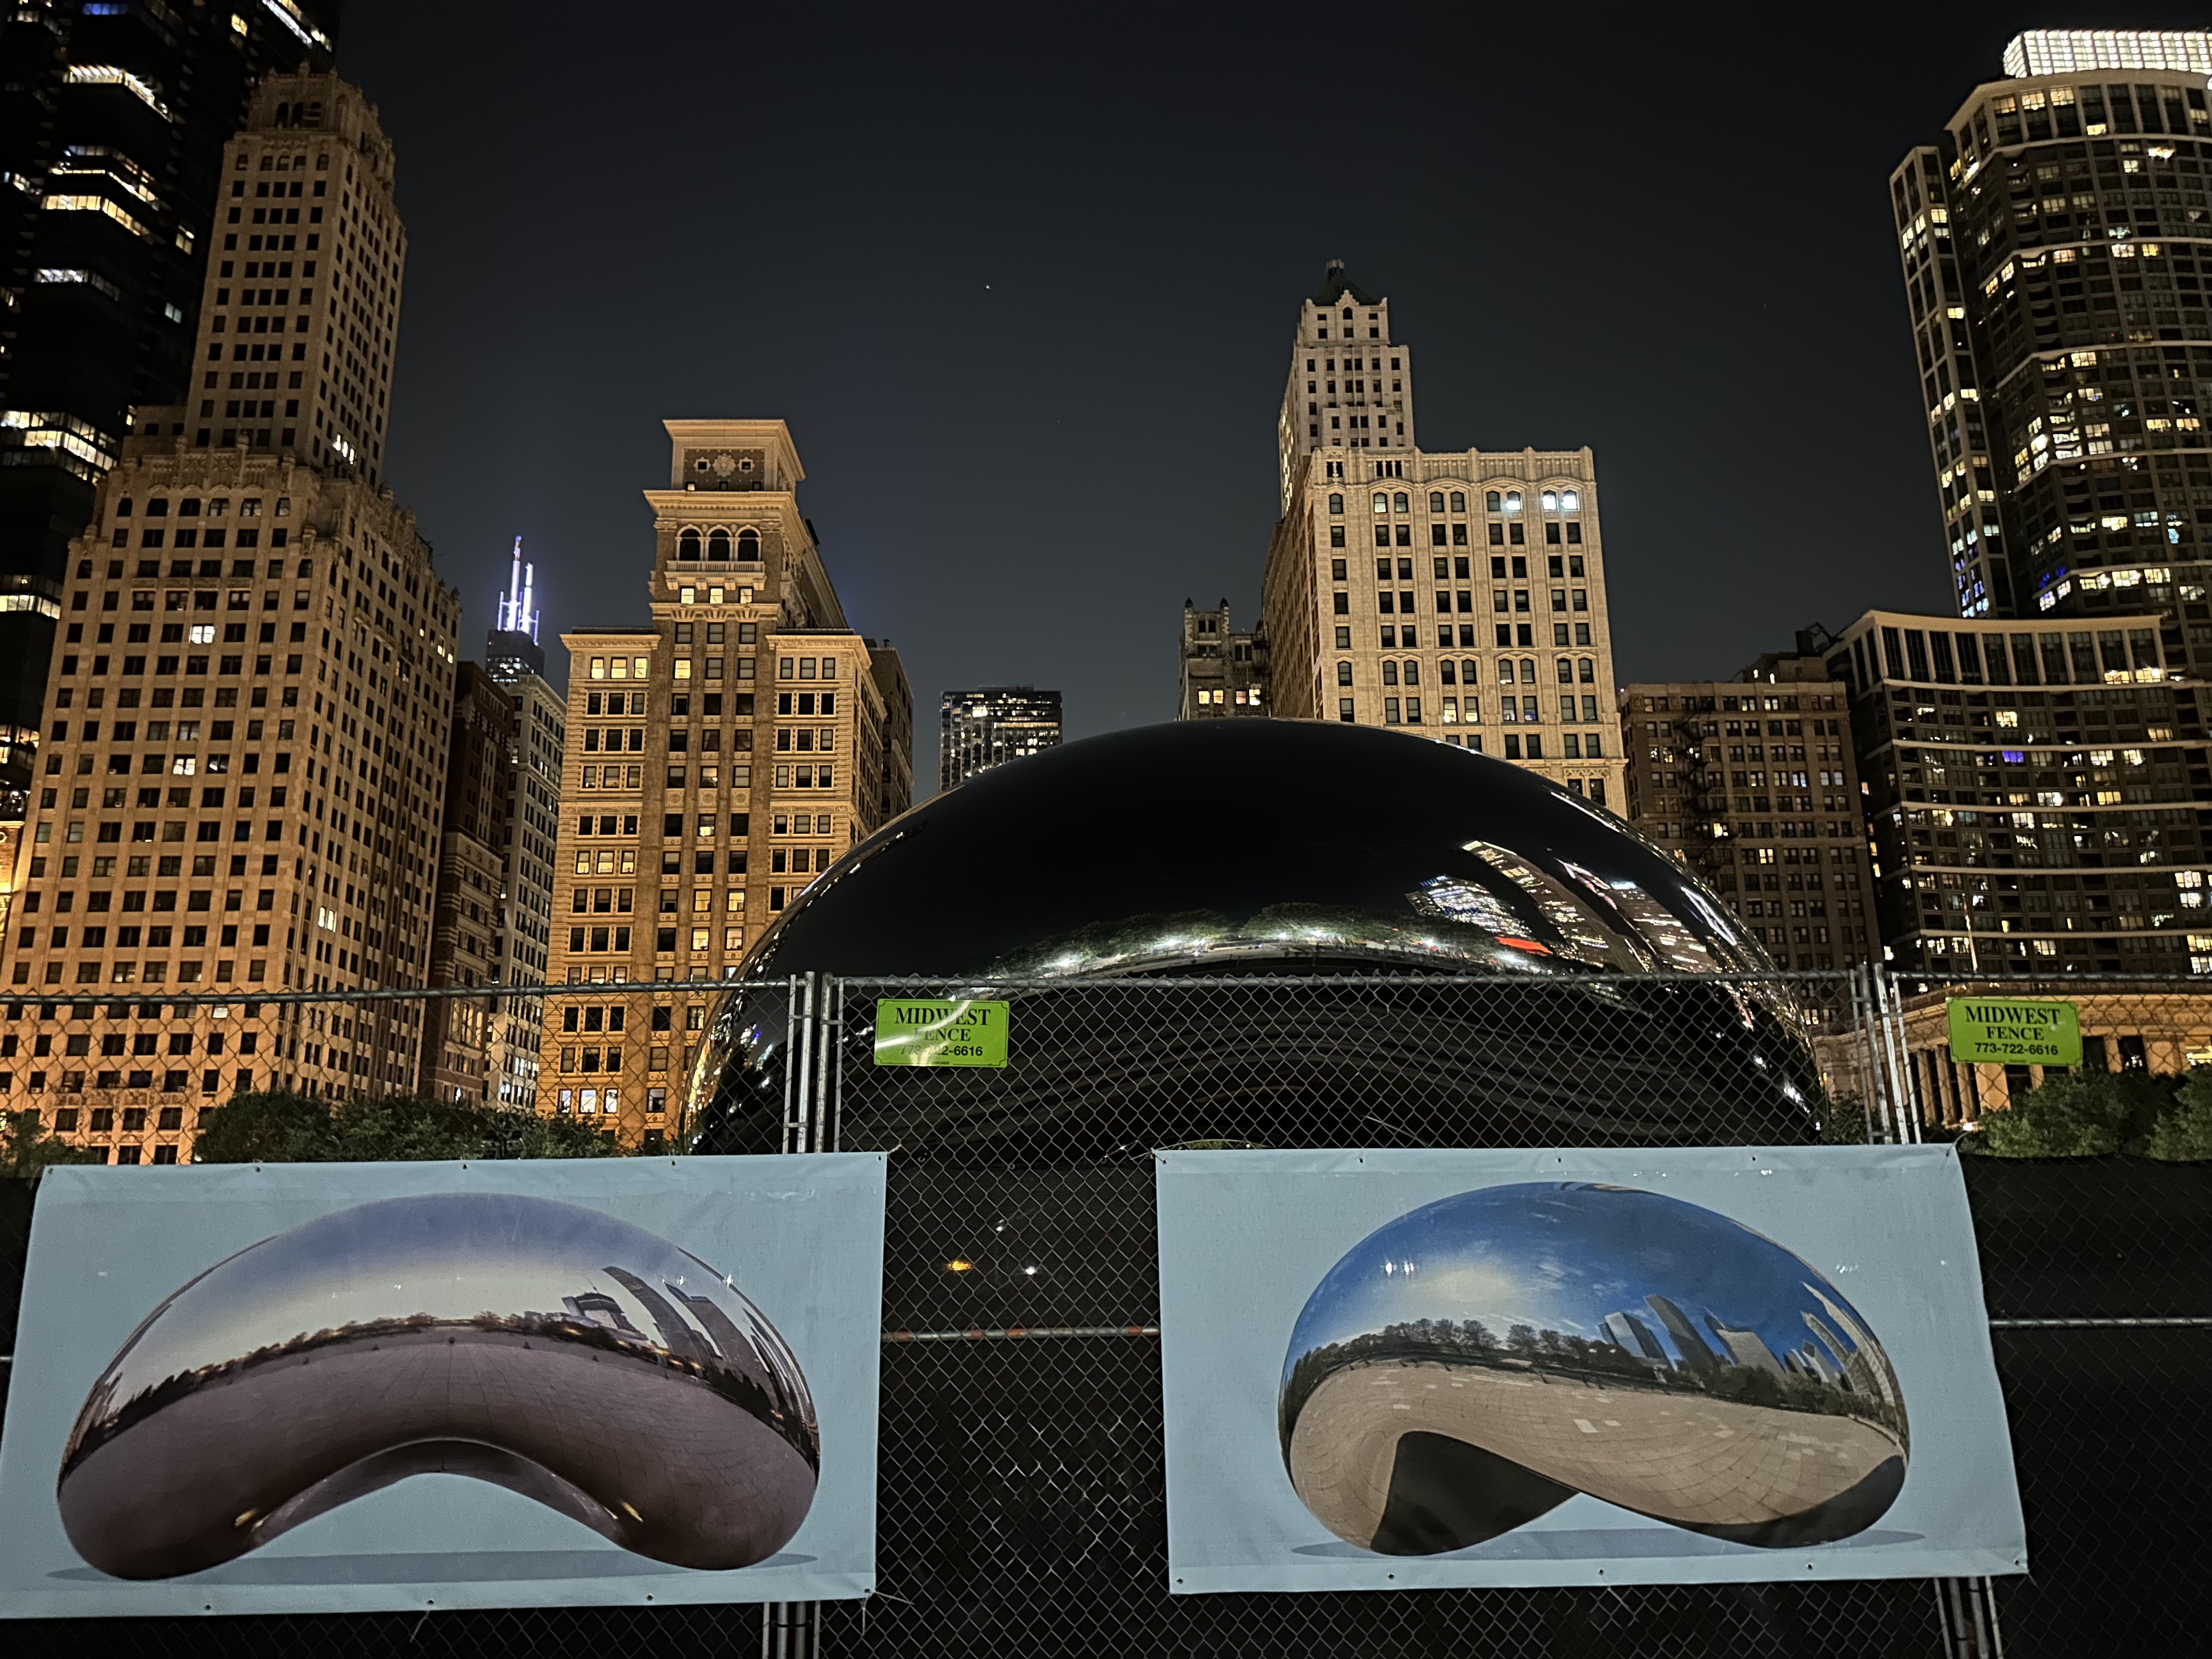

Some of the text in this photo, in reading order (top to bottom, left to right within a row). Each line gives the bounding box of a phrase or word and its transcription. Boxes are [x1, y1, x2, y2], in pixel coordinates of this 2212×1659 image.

[895, 1007, 991, 1026] MIDWEST
[1966, 1006, 2059, 1025] MIDWEST
[1986, 1026, 2044, 1040] FENCE
[1976, 1043, 2058, 1055] 773-722-6616
